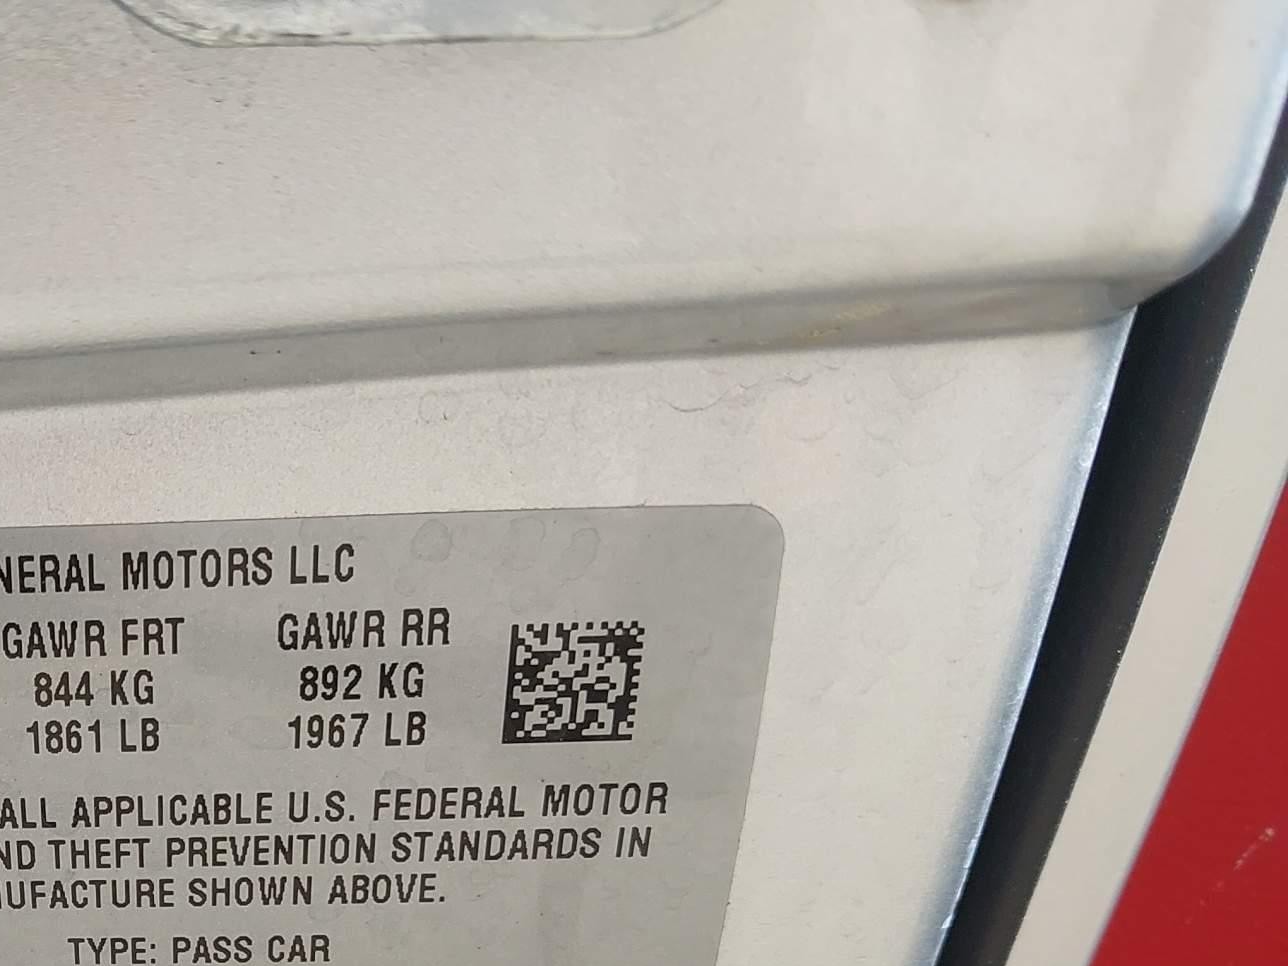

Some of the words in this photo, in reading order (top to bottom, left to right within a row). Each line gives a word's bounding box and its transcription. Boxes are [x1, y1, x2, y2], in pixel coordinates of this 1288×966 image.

[122, 546, 273, 591] MOTORS
[290, 543, 355, 585] LLC
[1, 619, 107, 660] GAWR
[121, 617, 185, 656] FRT
[277, 609, 386, 651] GAWR
[401, 607, 450, 647] RR
[33, 670, 95, 708] 844
[110, 669, 154, 706] KG
[299, 663, 363, 702] 892
[378, 661, 425, 699] KG
[26, 718, 101, 755] 1861
[120, 717, 160, 753] LB
[287, 712, 369, 750] 1967
[384, 710, 427, 747] LB
[71, 792, 273, 829] APPLICABLE
[288, 790, 355, 823] U.S.
[372, 785, 525, 822] FEDERAL
[541, 781, 669, 817] MOTOR
[47, 837, 151, 870] THEFT
[166, 832, 376, 868] PREVENTION
[391, 827, 602, 863] STANDARDS
[615, 826, 652, 858] IN
[188, 875, 313, 907] SHOWN
[327, 873, 445, 905] ABOVE.
[67, 937, 156, 965] TYPE:
[172, 935, 253, 964] PASS
[267, 934, 331, 963] CAR
